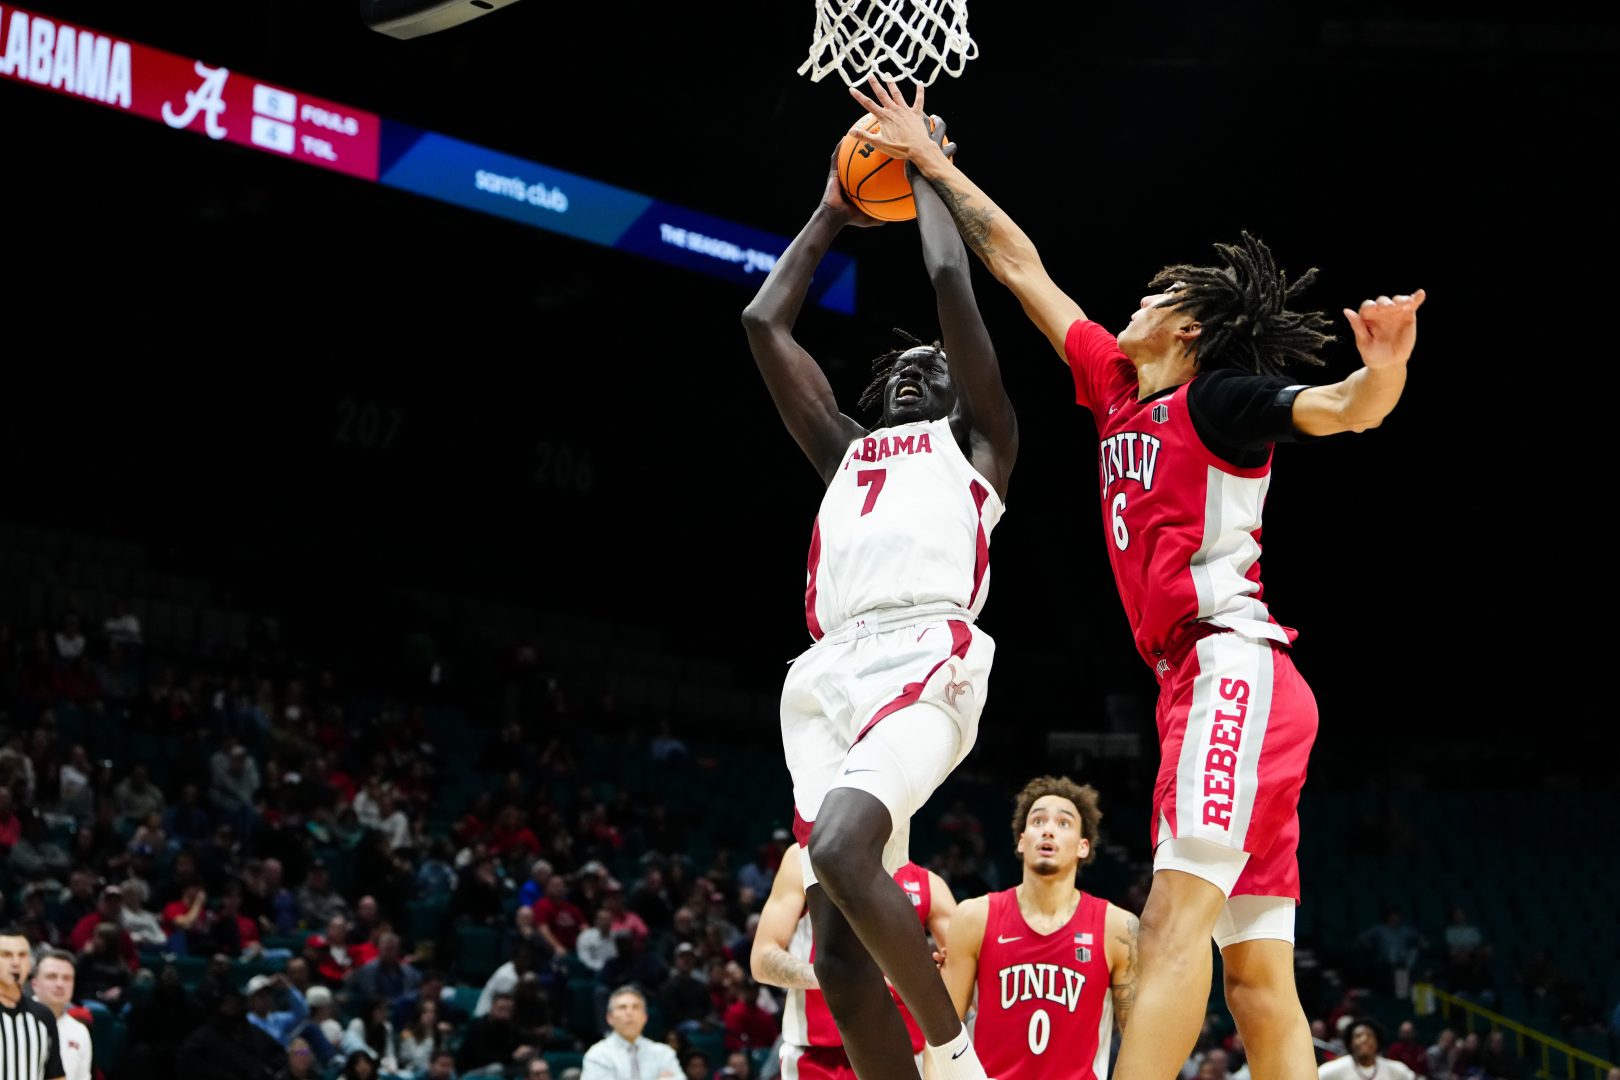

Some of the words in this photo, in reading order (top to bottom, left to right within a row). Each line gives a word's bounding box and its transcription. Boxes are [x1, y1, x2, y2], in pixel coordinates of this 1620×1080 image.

[526, 182, 569, 213] club
[660, 223, 687, 249] THE
[334, 396, 405, 452] 207
[531, 439, 598, 495] 206
[857, 468, 887, 517] 7
[1112, 492, 1130, 551] 6
[1202, 677, 1250, 832] REBELS
[998, 963, 1086, 1013] UNLV
[1028, 1009, 1051, 1055] 0
